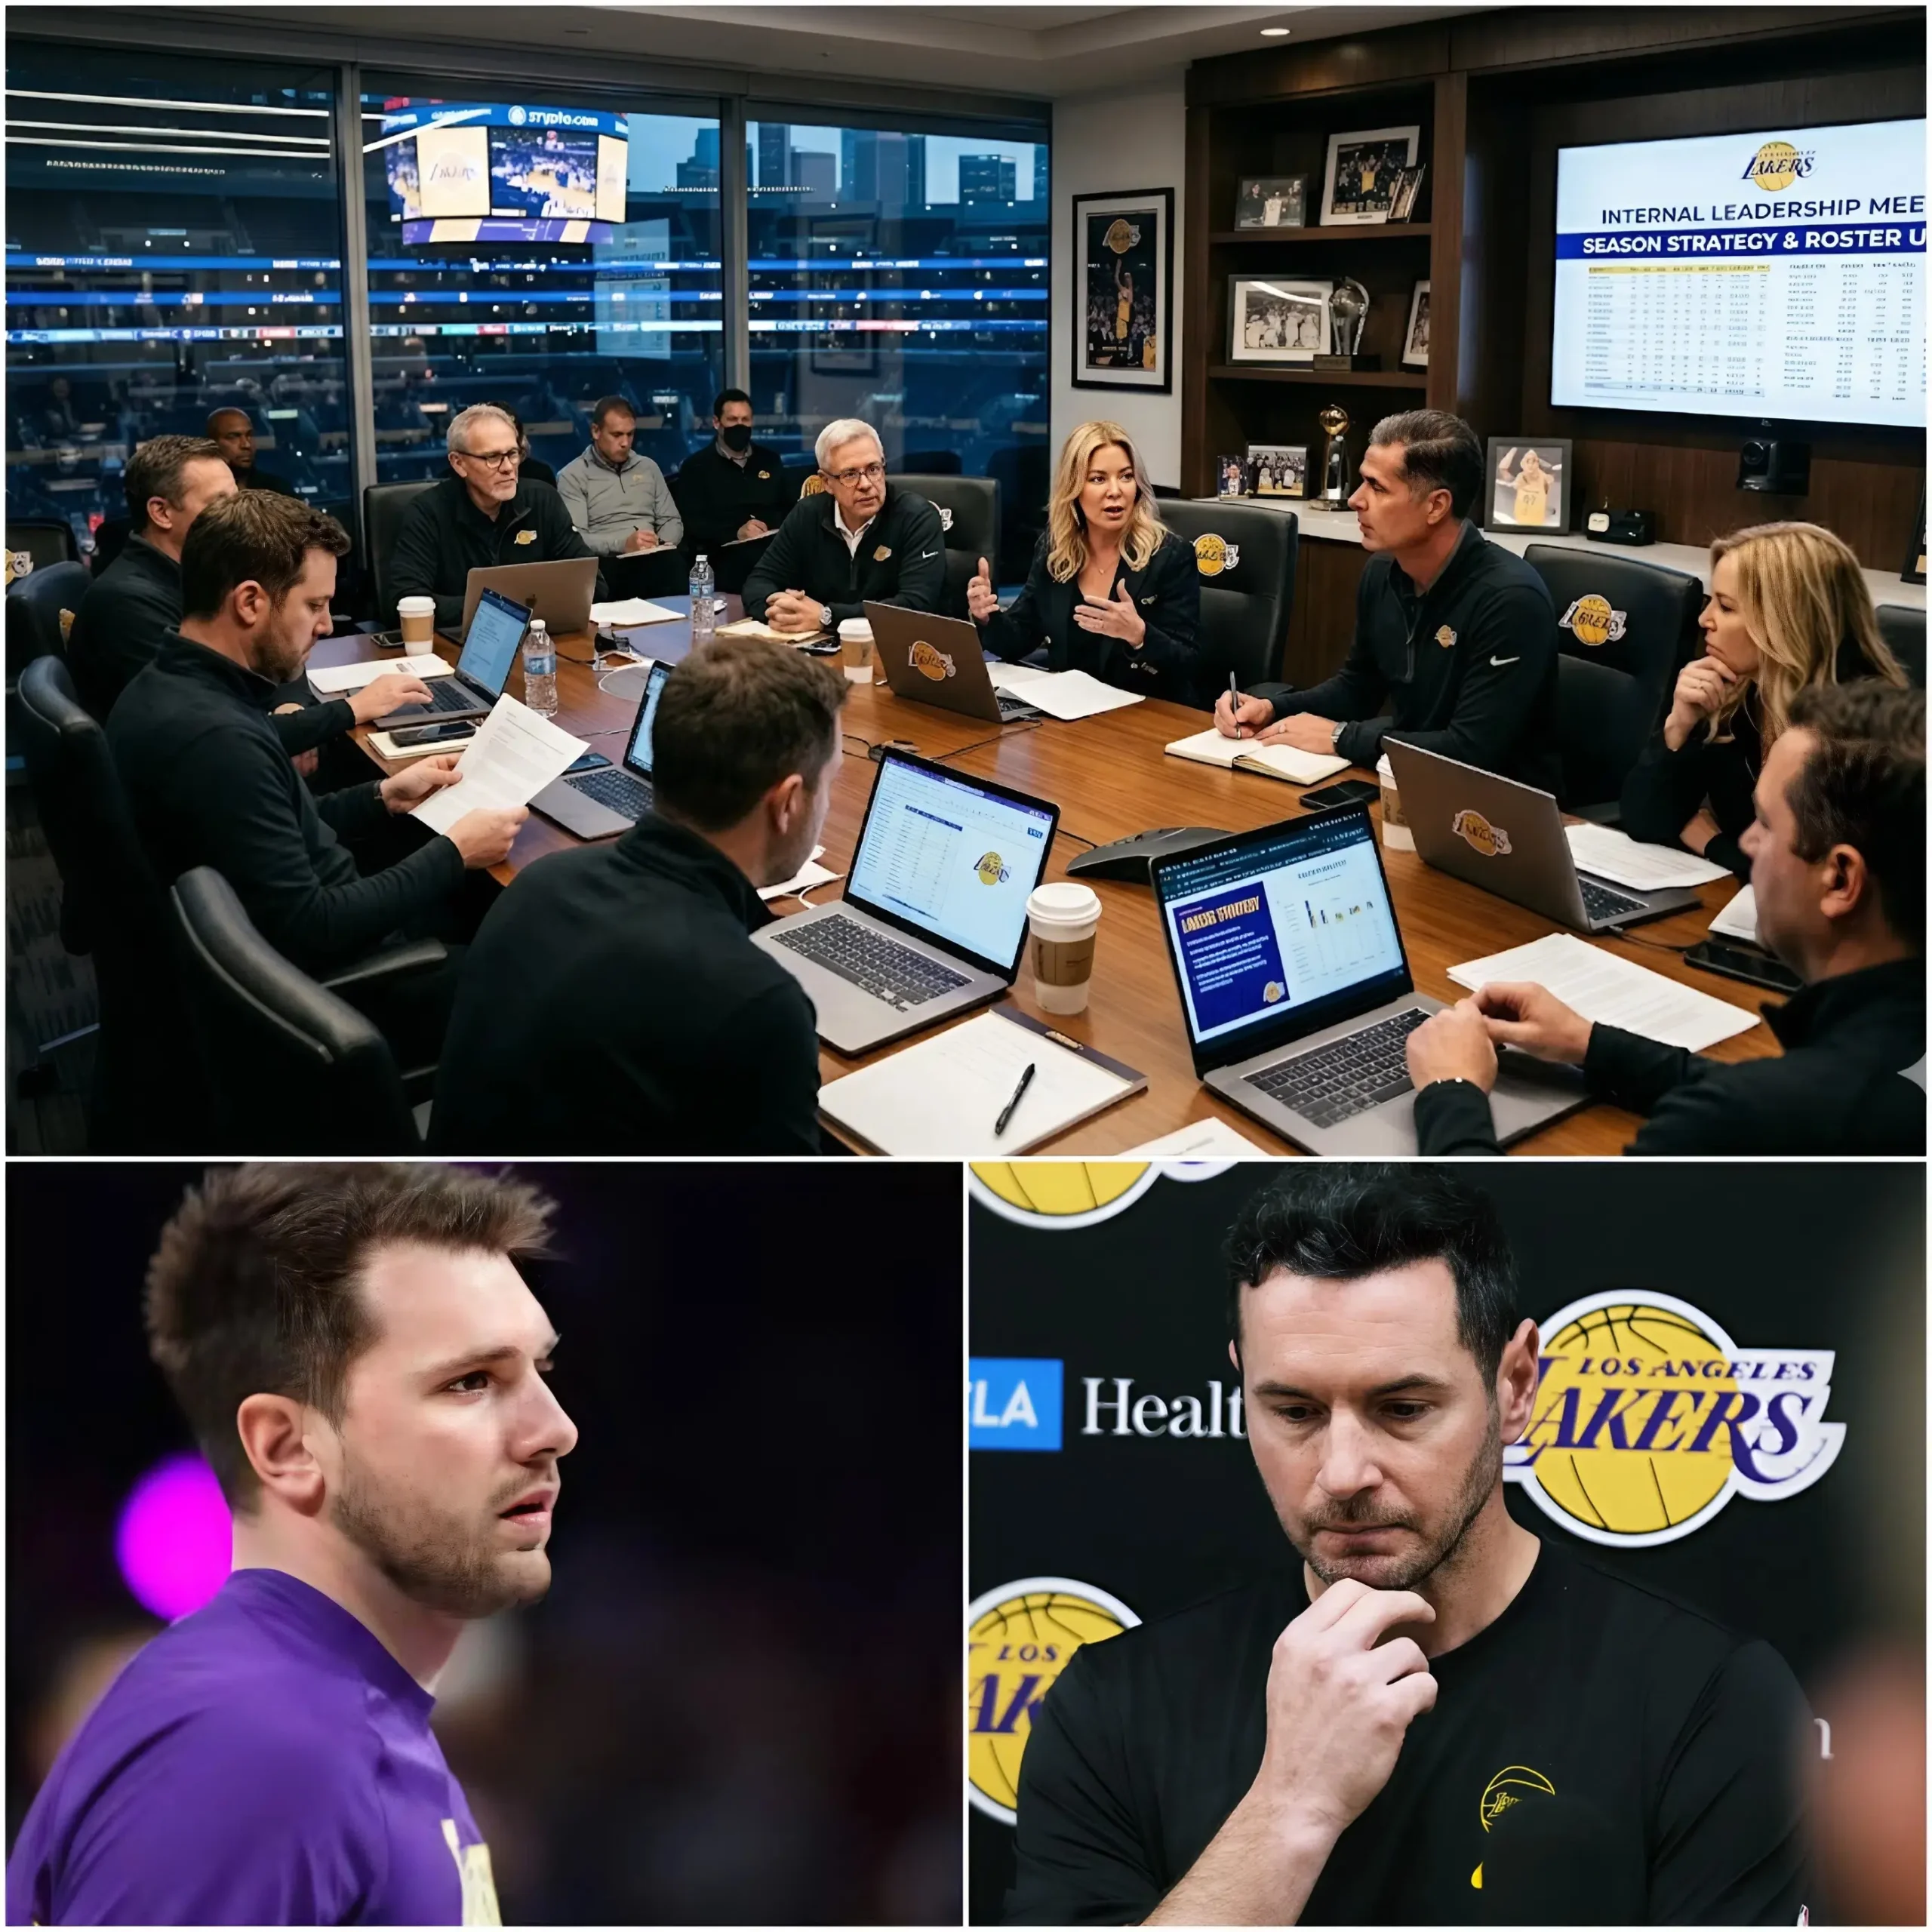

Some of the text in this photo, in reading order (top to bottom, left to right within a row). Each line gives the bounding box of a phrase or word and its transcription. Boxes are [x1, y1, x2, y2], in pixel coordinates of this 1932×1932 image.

[1602, 195, 1925, 224] INTERNAL LEADERSHIP MEE
[1583, 235, 1661, 254] SEASON
[1667, 232, 1778, 252] STRATEGY
[1783, 231, 1798, 250] &
[1805, 229, 1902, 248] ROSTER
[1578, 1357, 1819, 1380] LOS ANGELES
[969, 1379, 1038, 1428] LA
[996, 1643, 1062, 1663] LOS
